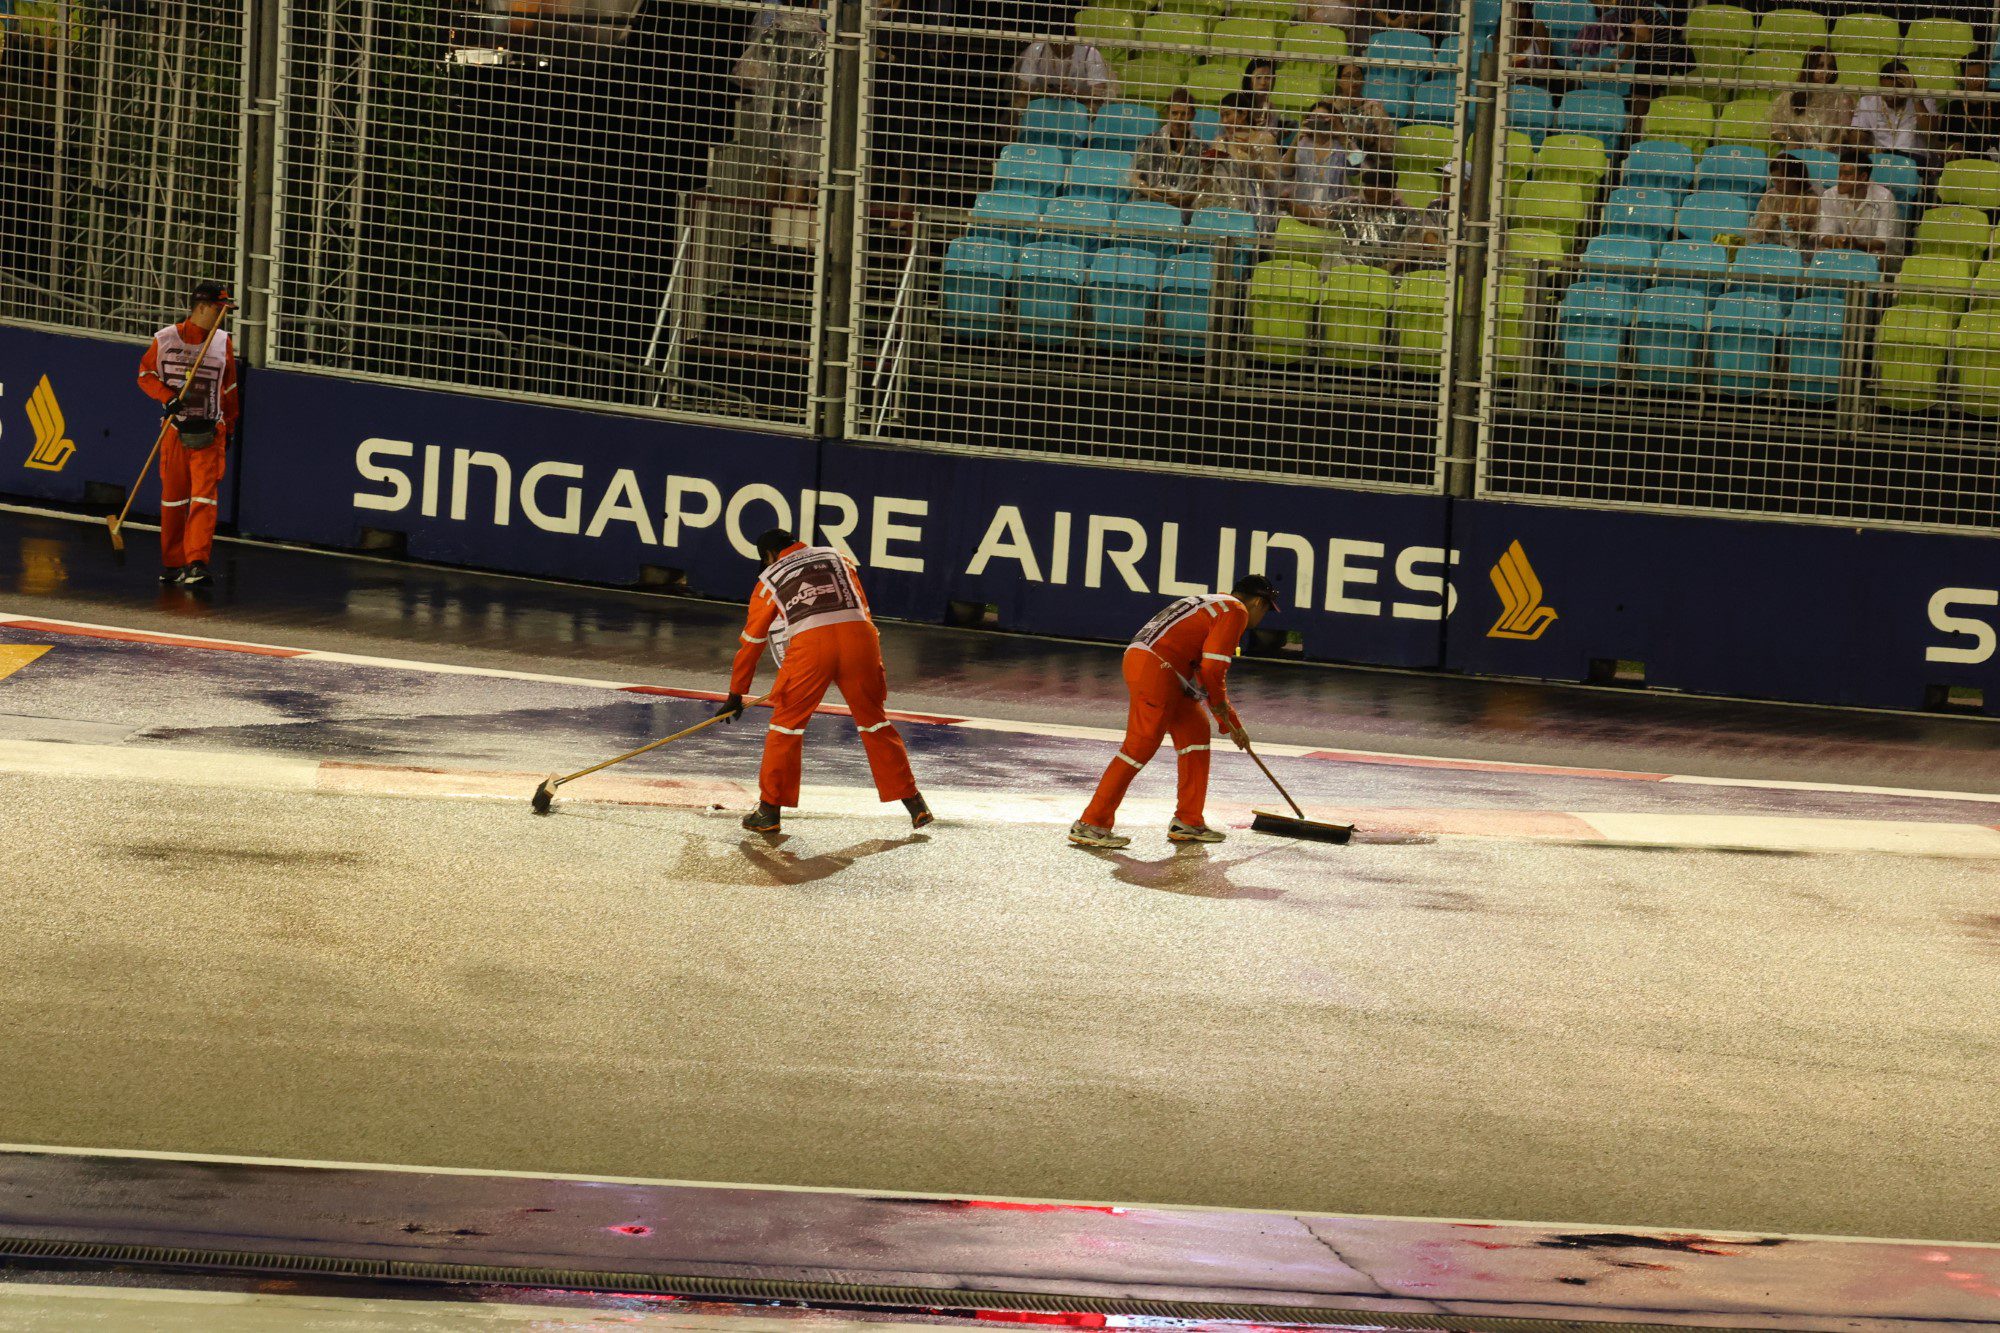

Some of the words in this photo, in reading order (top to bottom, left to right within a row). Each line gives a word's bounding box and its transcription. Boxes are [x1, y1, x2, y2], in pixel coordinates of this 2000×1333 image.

[353, 437, 929, 574] SINGAPORE
[965, 505, 1461, 621] AIRLINES
[785, 583, 836, 611] COURSE
